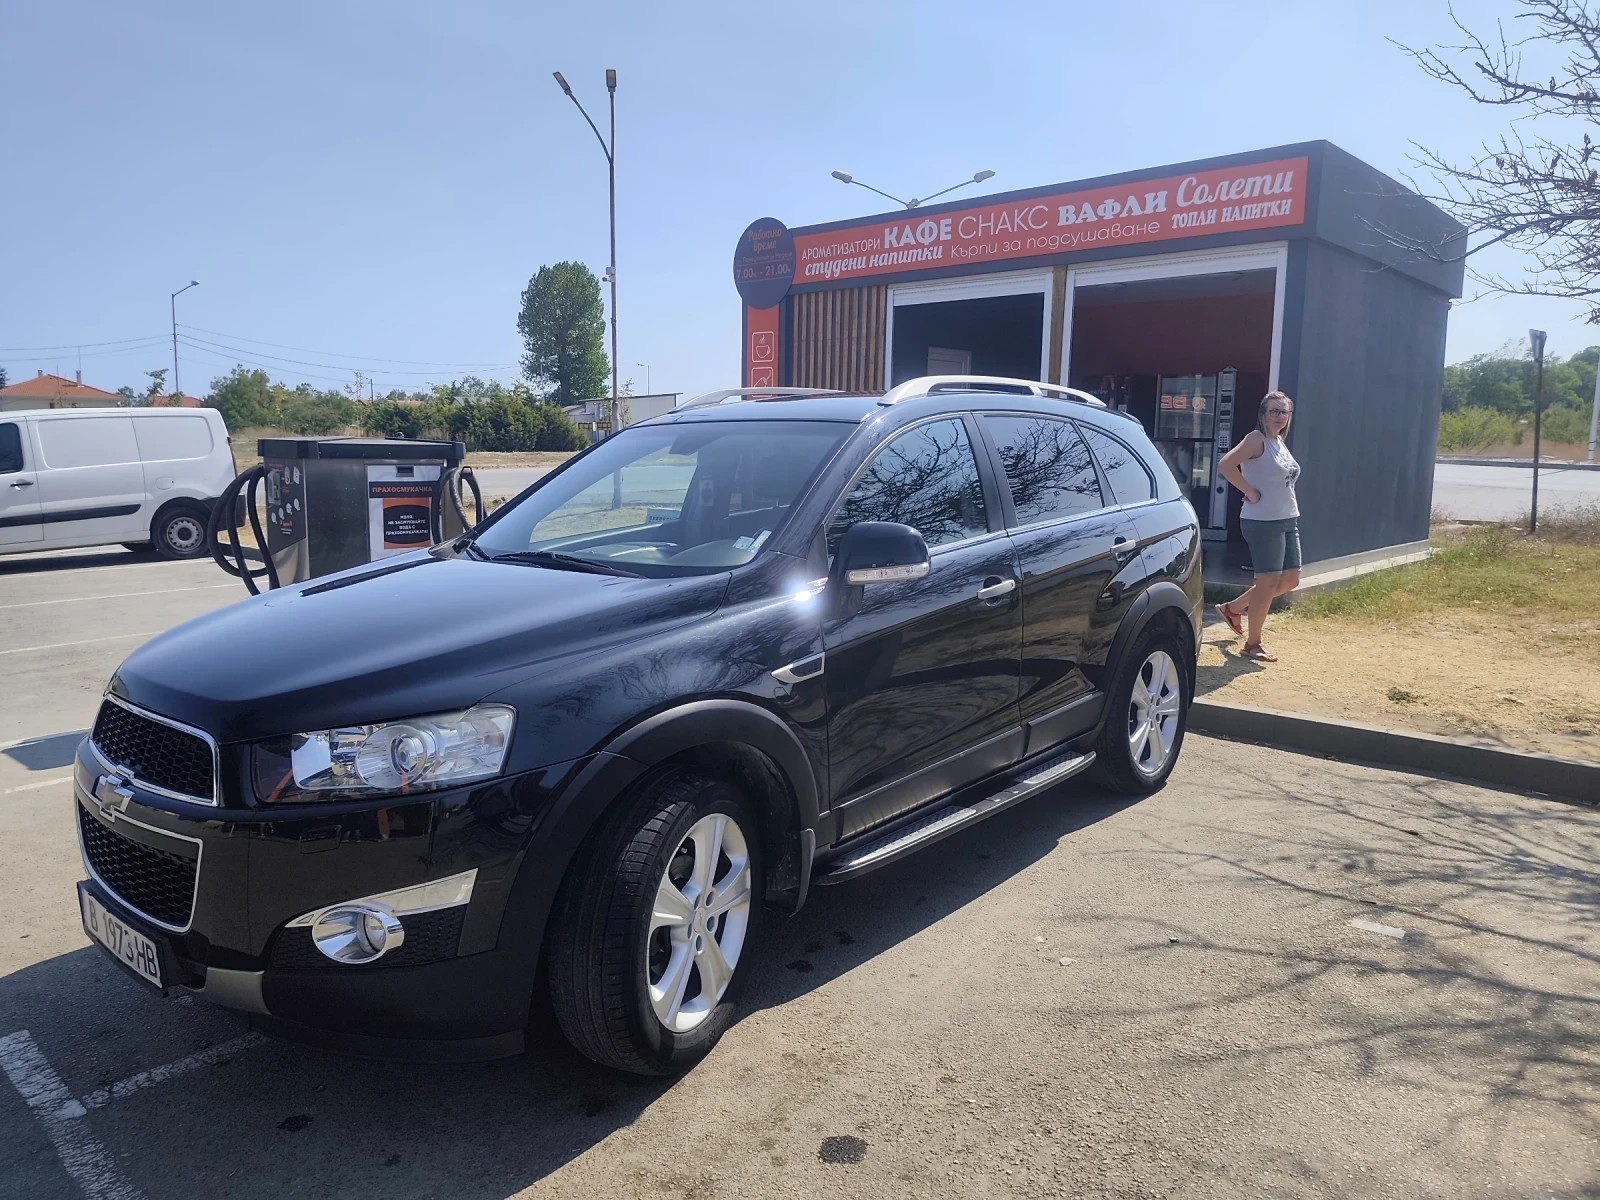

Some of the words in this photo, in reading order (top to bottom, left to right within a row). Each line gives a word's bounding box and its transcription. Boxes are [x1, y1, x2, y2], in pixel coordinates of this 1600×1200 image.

[747, 228, 782, 241] Работно
[753, 240, 777, 254] време
[801, 237, 881, 261] АРОМАТИЗАТОРИ
[884, 218, 953, 249] КАФЕ
[958, 205, 1049, 239] СНАКС
[1057, 190, 1168, 227] ВАФЛИ
[1176, 170, 1294, 208] Солети
[804, 257, 867, 279] студени
[868, 245, 943, 268] напитки
[951, 238, 998, 259] Кърпи
[1002, 239, 1021, 252] за
[1026, 221, 1160, 250] подсушаване
[1171, 208, 1217, 229] ТОПЛИ
[1220, 199, 1293, 223] НАПИТКИ
[88, 898, 99, 933] B
[134, 935, 158, 979] HB
